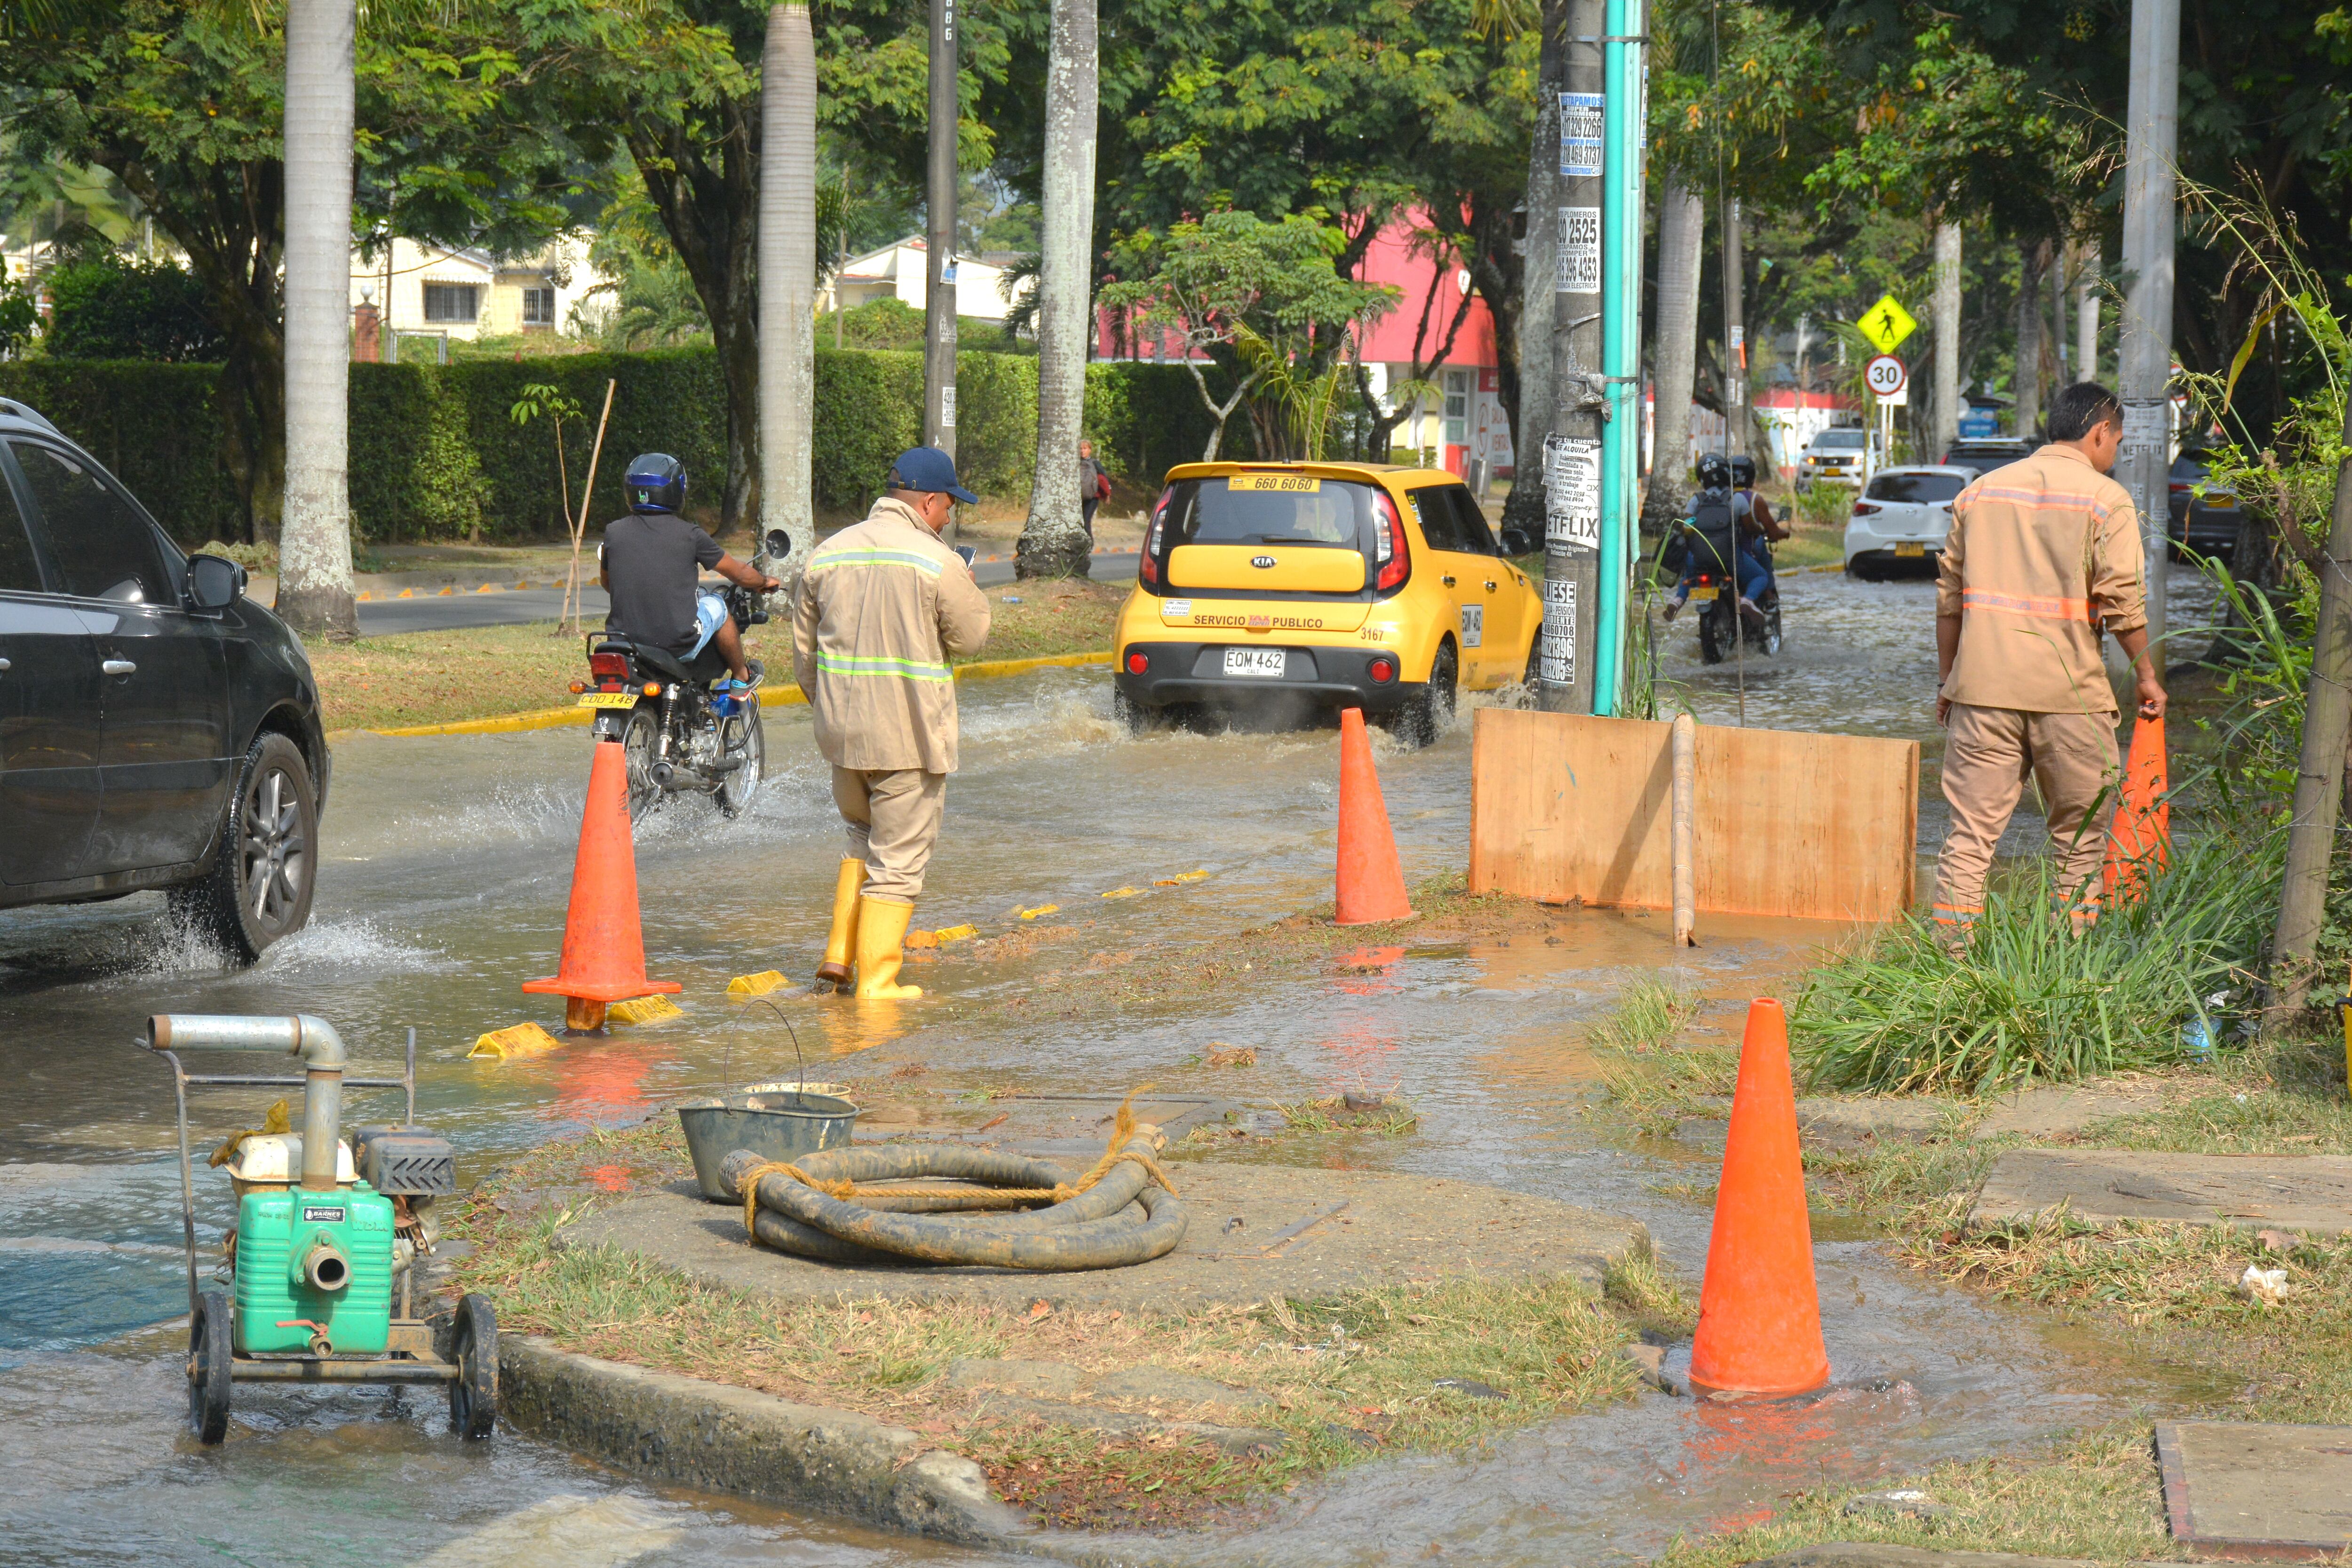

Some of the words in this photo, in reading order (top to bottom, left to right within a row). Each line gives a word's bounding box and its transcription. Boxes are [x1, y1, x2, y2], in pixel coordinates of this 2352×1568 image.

[1571, 118, 1582, 138] 329
[1583, 118, 1601, 138] 2266
[1571, 146, 1583, 164] 469
[1584, 146, 1601, 165] 3737
[1569, 218, 1597, 244] 2525
[1565, 257, 1576, 282] 396
[1579, 257, 1597, 282] 4353
[1874, 367, 1897, 383] 30
[1564, 446, 1589, 454] ALQUILA
[2122, 445, 2163, 456] NETFLIX
[1255, 478, 1278, 489] 660
[1548, 513, 1598, 539] ETFLIX
[1254, 557, 1272, 566] KIA
[1555, 604, 1575, 616] PENSIÓN
[1194, 615, 1245, 625] SERVICIO
[1273, 617, 1322, 628] PUBLICO
[1361, 627, 1384, 641] 3167
[1256, 653, 1282, 669] 462
[609, 695, 634, 704] 14B
